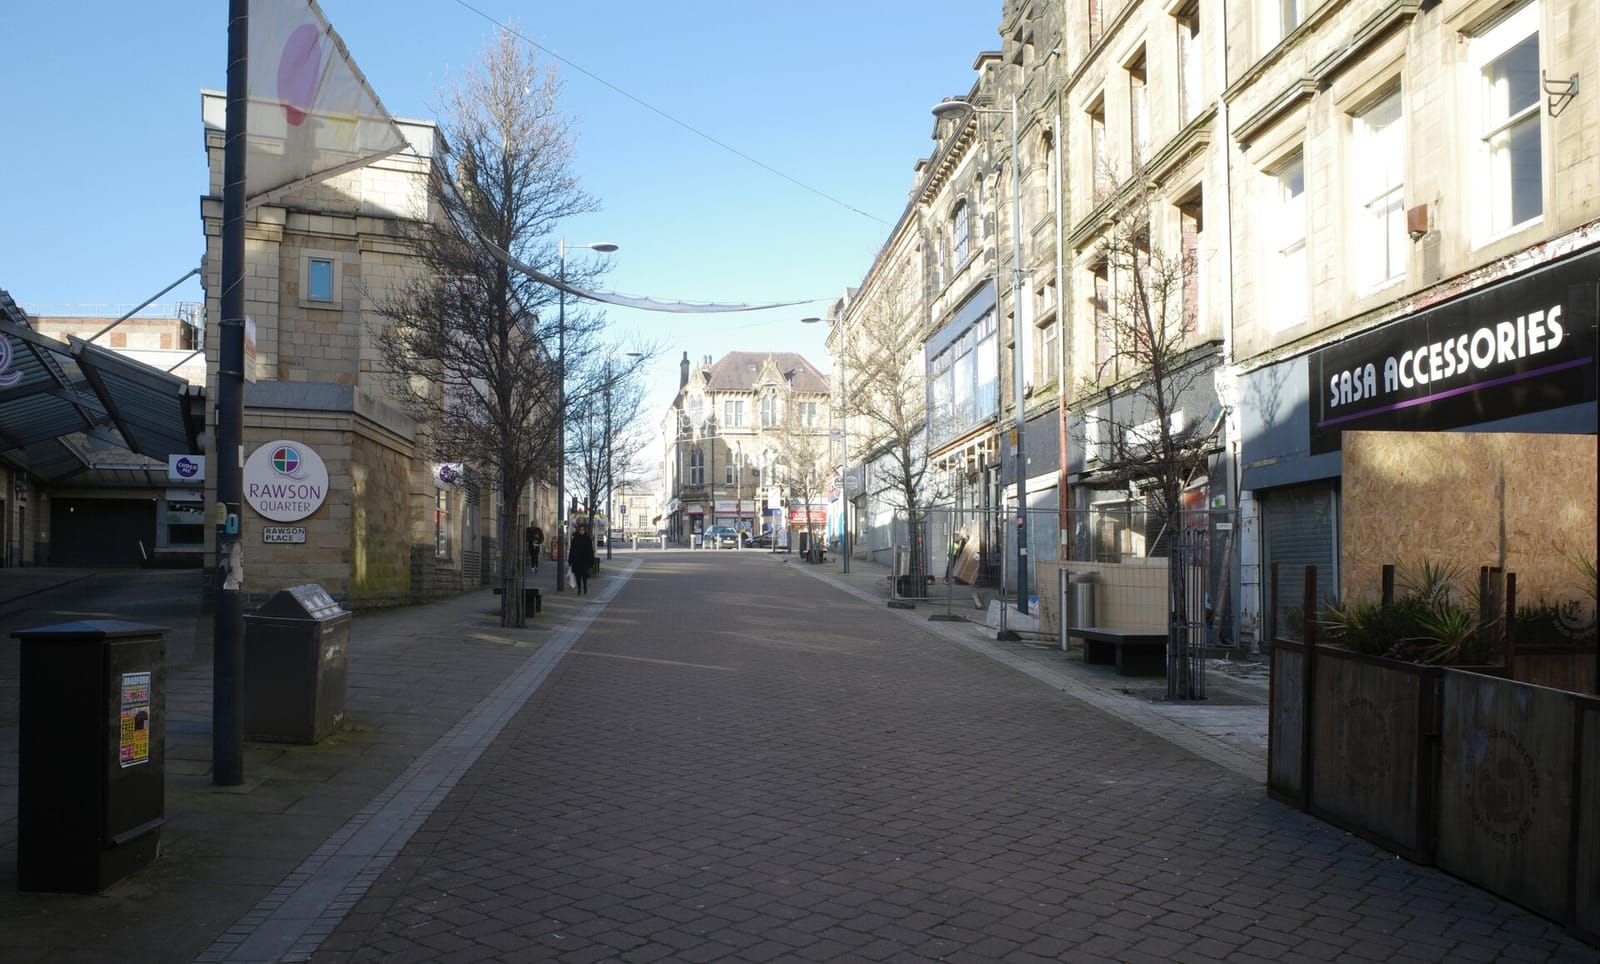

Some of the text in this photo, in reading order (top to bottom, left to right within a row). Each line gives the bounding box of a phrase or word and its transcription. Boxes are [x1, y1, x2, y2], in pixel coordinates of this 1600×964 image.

[1330, 304, 1564, 408] SASA ACCESSORIES
[249, 483, 321, 500] RAWSON
[260, 500, 311, 513] QUARTER
[265, 527, 305, 535] RAWSON
[265, 534, 295, 542] PLACE
